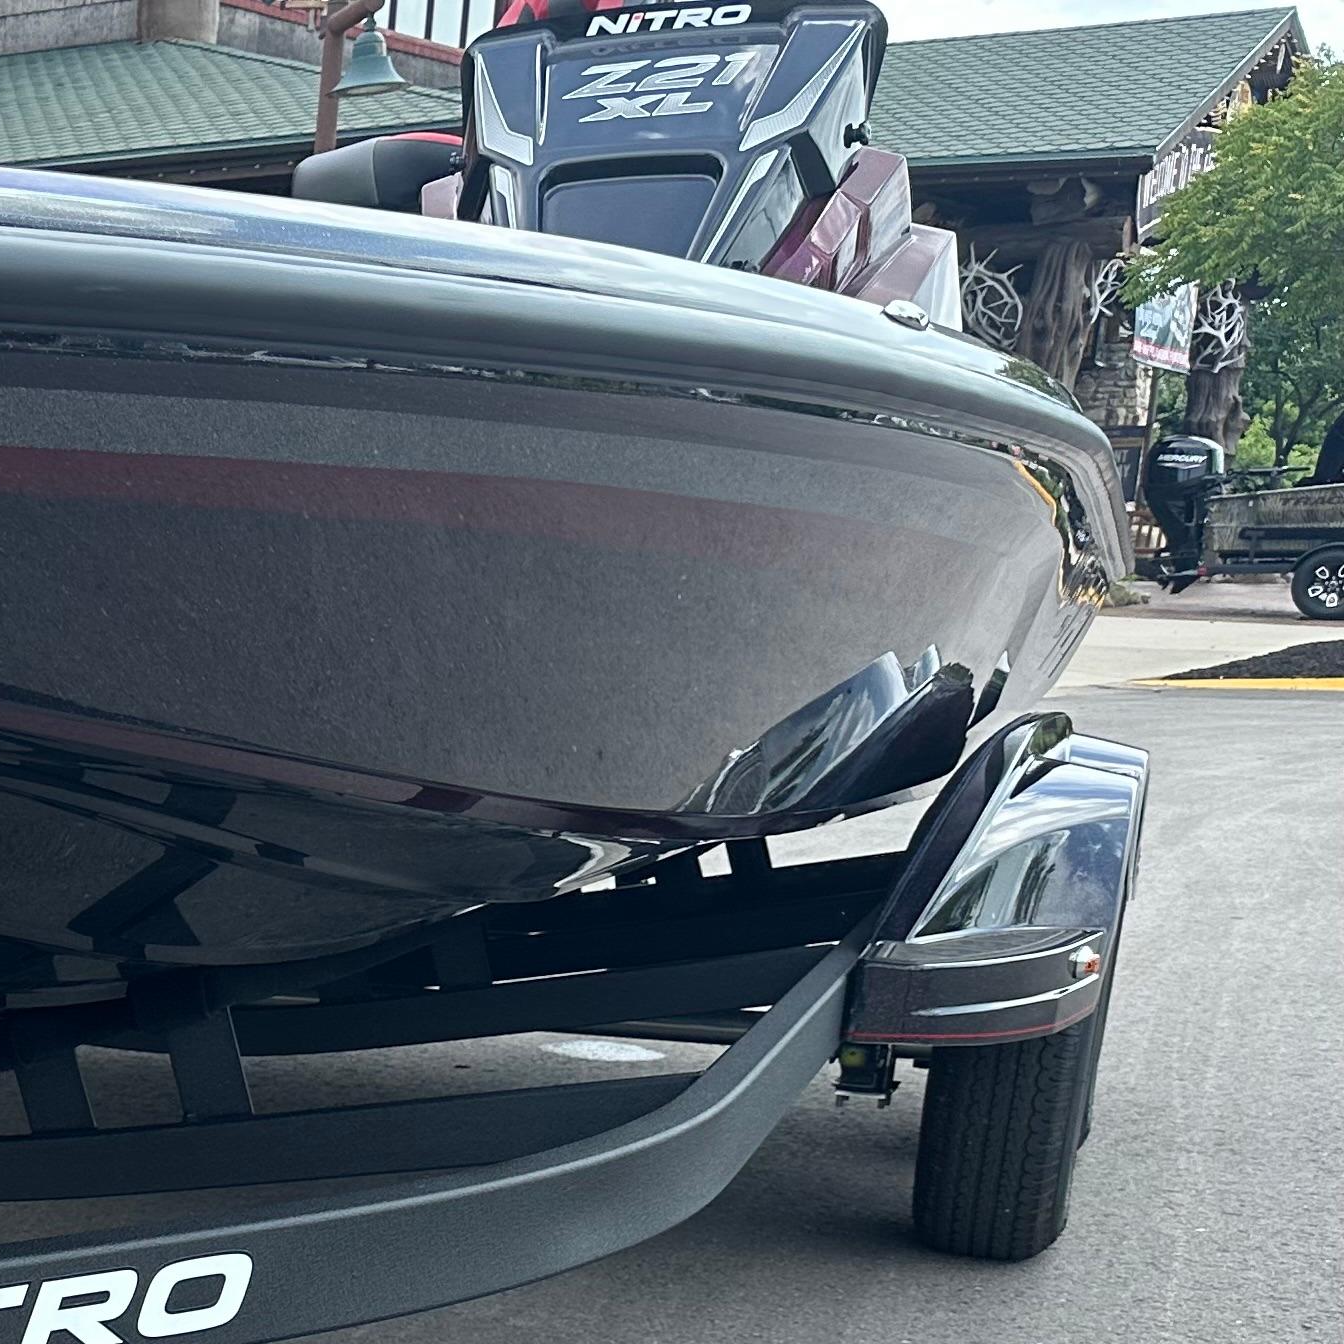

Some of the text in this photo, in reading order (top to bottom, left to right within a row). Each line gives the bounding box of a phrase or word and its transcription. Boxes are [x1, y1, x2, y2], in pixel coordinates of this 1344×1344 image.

[586, 4, 752, 37] NITRO
[562, 52, 755, 100] Z21
[579, 91, 713, 123] XL
[1157, 453, 1208, 465] MERCURY
